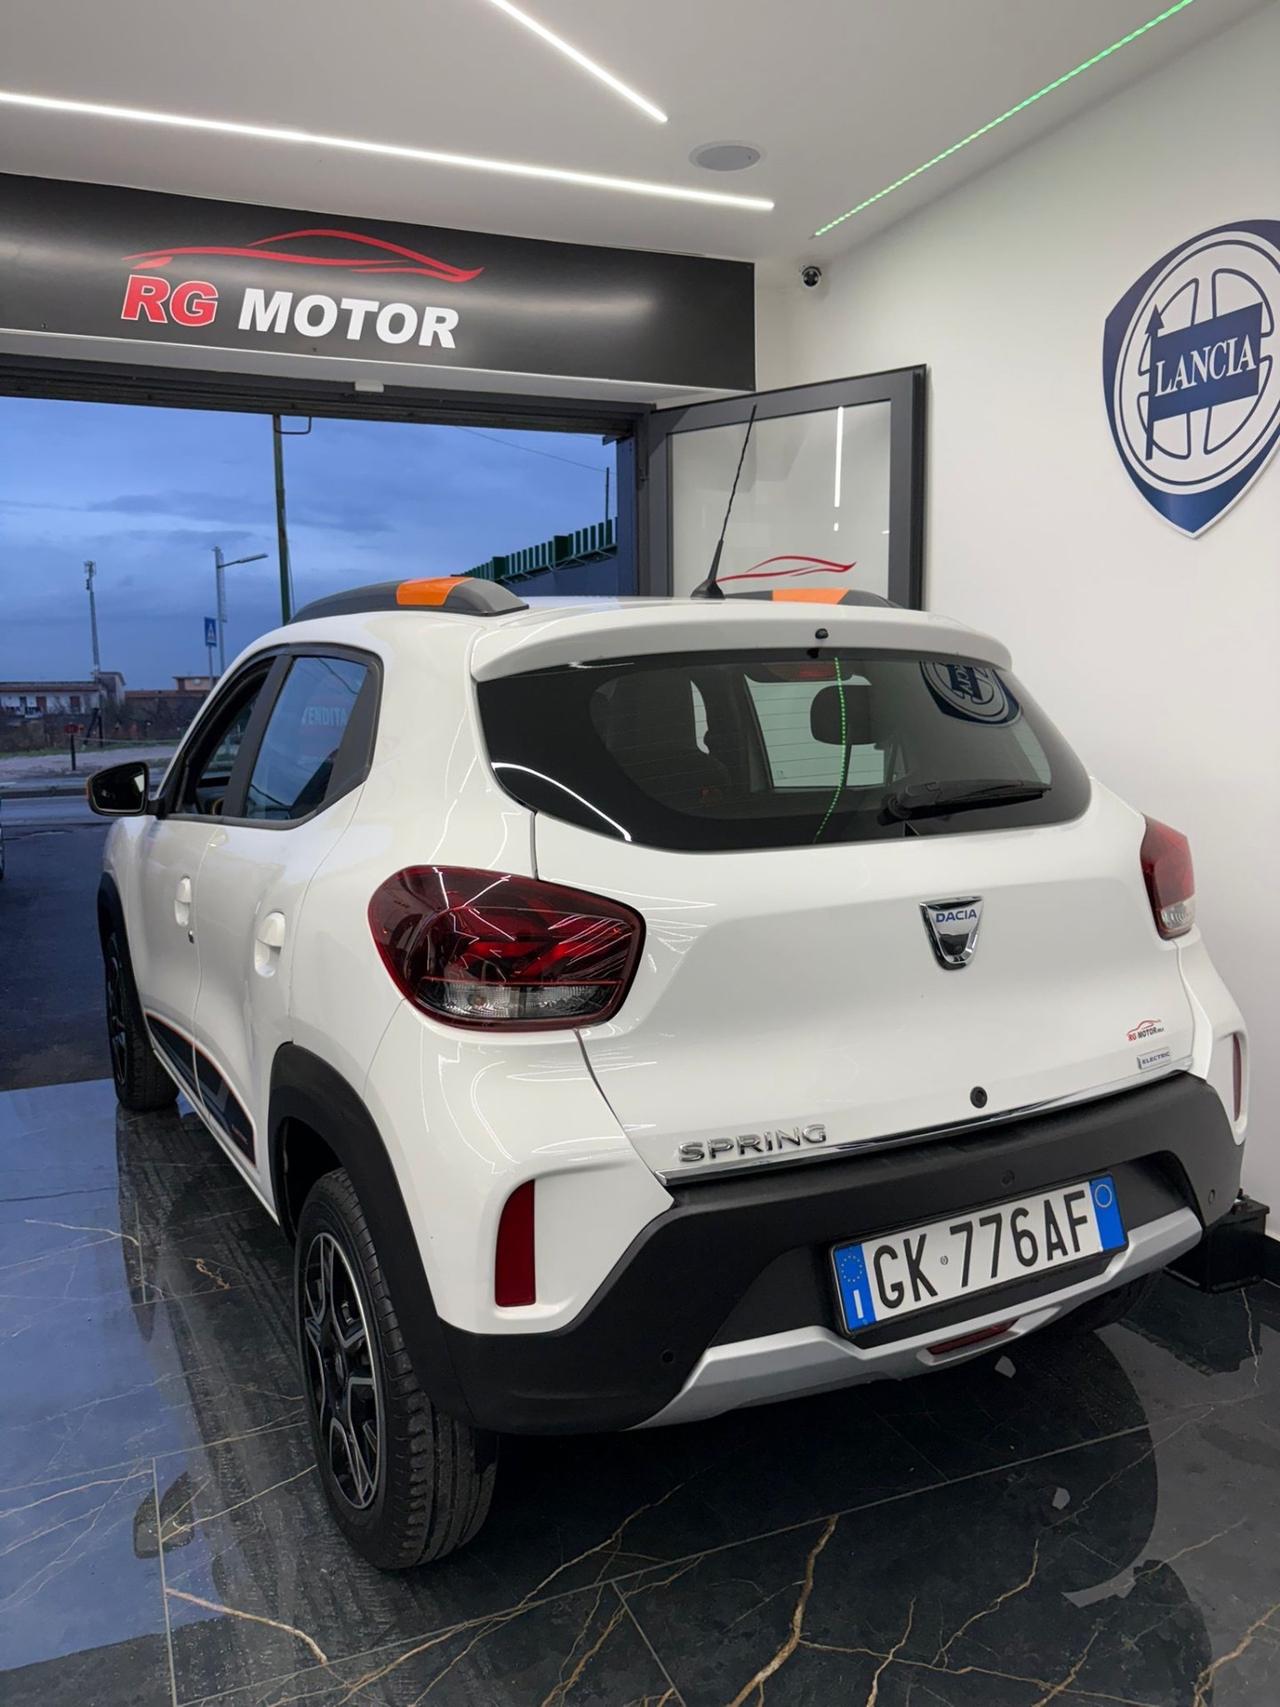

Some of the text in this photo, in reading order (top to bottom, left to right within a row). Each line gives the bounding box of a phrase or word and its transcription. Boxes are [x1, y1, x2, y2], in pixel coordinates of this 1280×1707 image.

[120, 273, 460, 349] RG MOTOR
[1154, 334, 1257, 398] LANCIA
[935, 909, 978, 924] DACIA
[1137, 1027, 1157, 1039] MOTOR
[1141, 1051, 1170, 1065] ELECTRIC
[678, 1122, 828, 1163] SPRING
[872, 1189, 1089, 1310] GK 776AF
